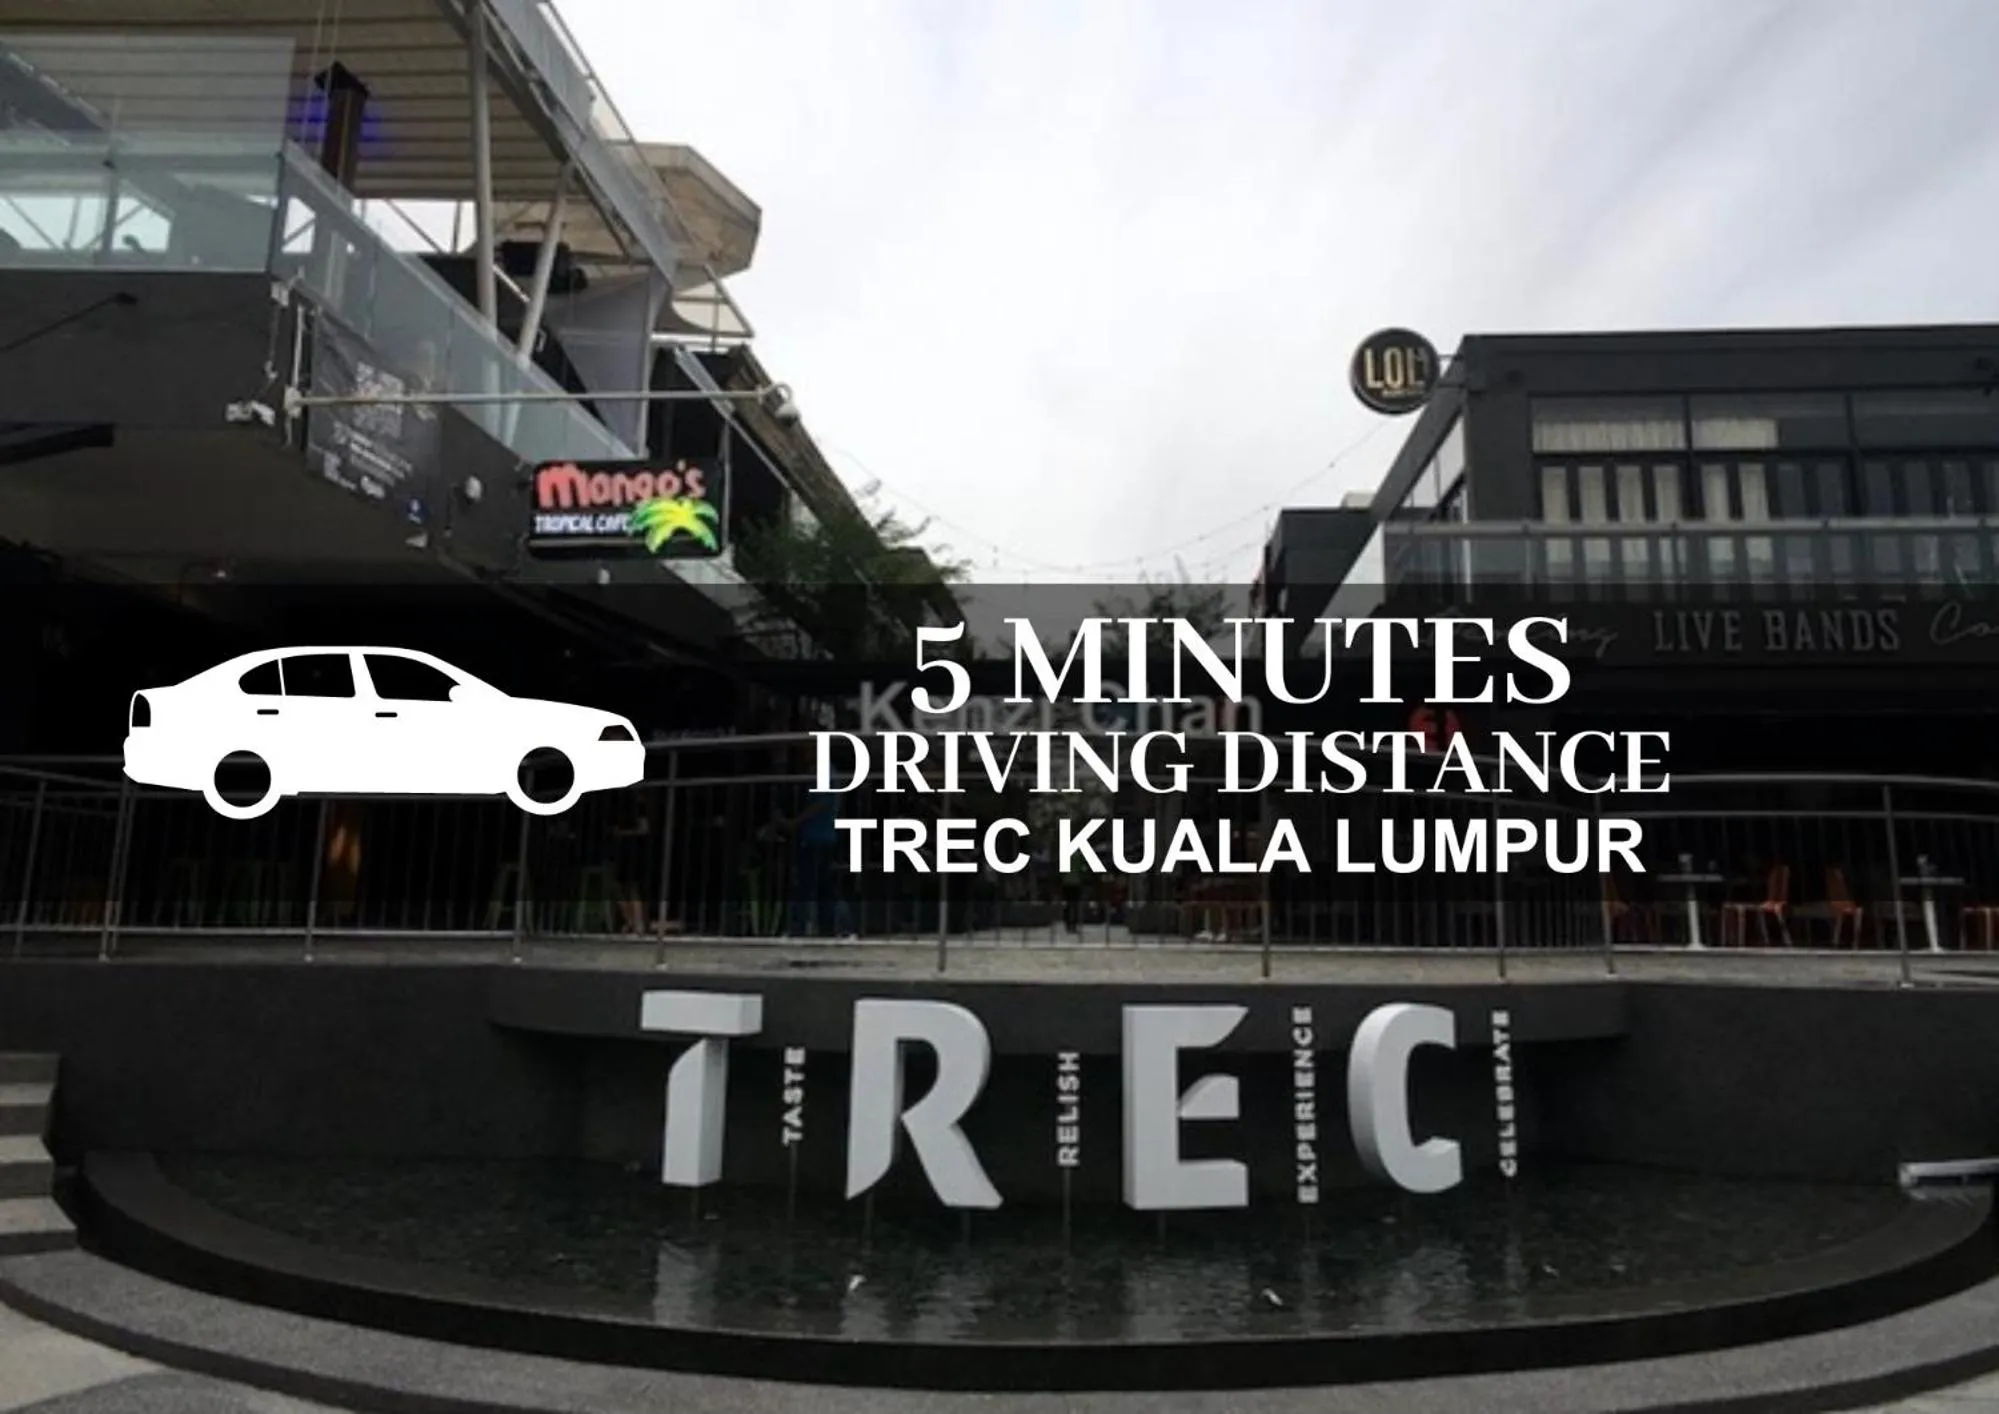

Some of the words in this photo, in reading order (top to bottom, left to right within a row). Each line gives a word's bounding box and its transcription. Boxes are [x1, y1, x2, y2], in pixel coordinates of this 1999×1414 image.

[534, 514, 594, 533] TROPICAL
[1654, 609, 1743, 652] LIVE
[1763, 608, 1899, 652] BANDS
[641, 990, 1464, 1210] TREC
[782, 1047, 806, 1146] TASTE
[1056, 1052, 1080, 1167] RELISH
[1291, 1006, 1319, 1204] EXPERIENCE
[1492, 1010, 1518, 1178] CELEBRATE
